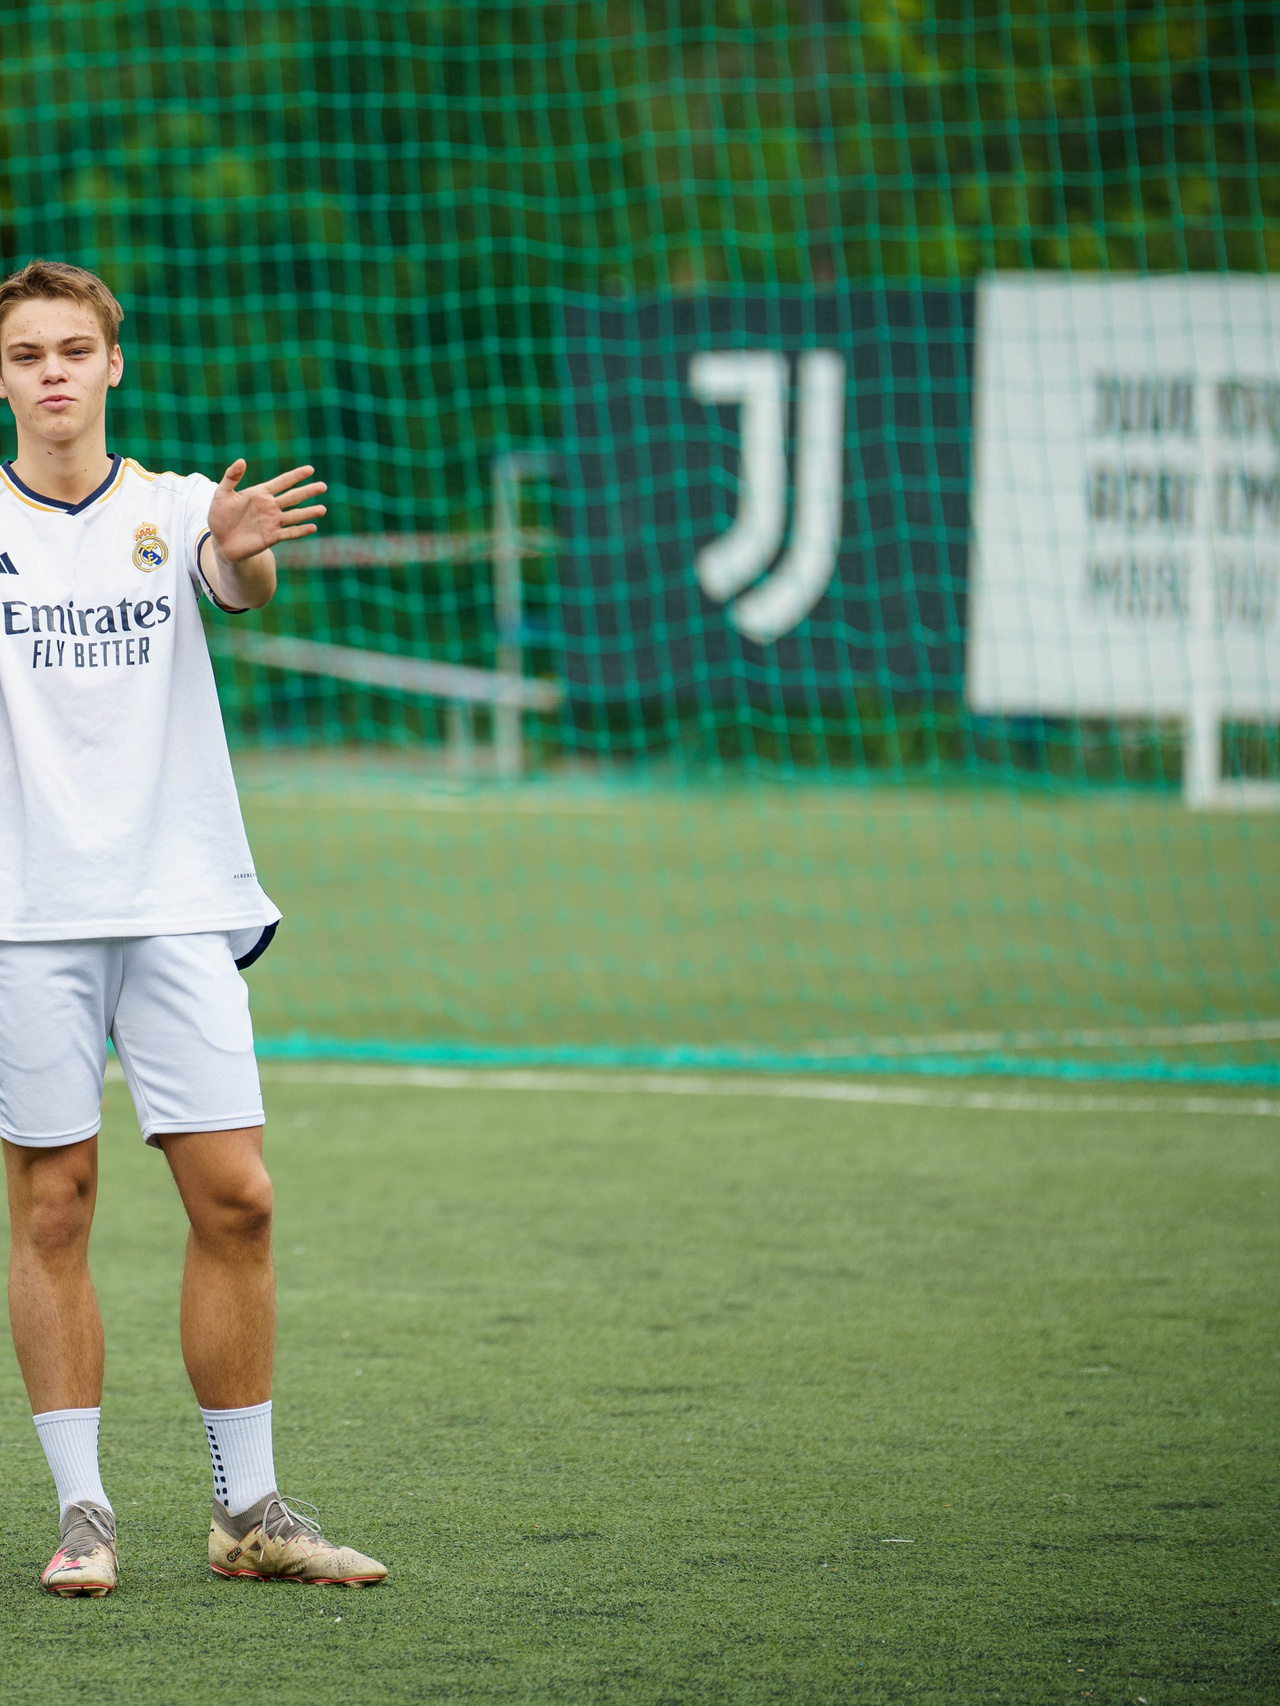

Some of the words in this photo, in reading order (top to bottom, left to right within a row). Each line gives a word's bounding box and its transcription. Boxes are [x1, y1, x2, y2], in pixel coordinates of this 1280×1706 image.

[1, 595, 171, 636] Emirates
[32, 638, 65, 669] FLY
[74, 636, 150, 668] BETTER
